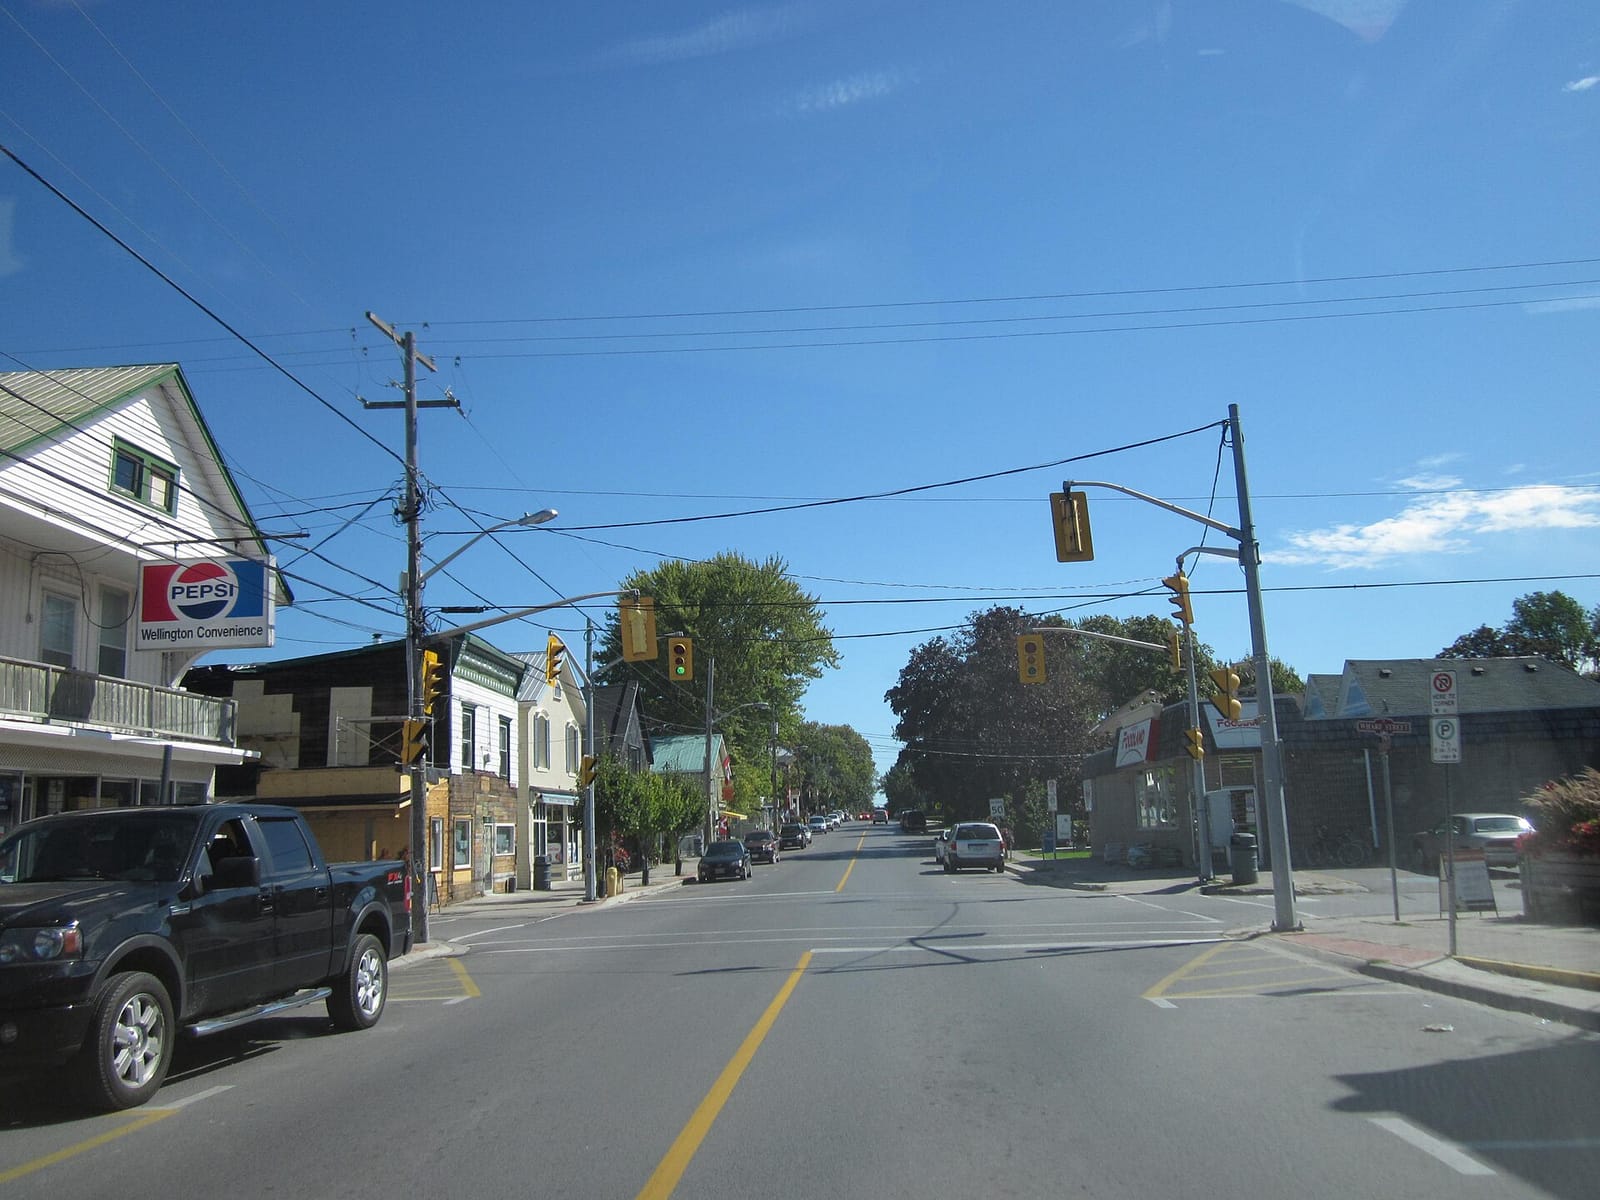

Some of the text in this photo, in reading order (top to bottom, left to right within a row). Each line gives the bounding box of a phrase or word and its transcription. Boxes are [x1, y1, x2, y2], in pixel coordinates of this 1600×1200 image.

[171, 583, 234, 600] PEPSI
[141, 624, 263, 642] Wellington Convenience
[991, 805, 1004, 815] 50
